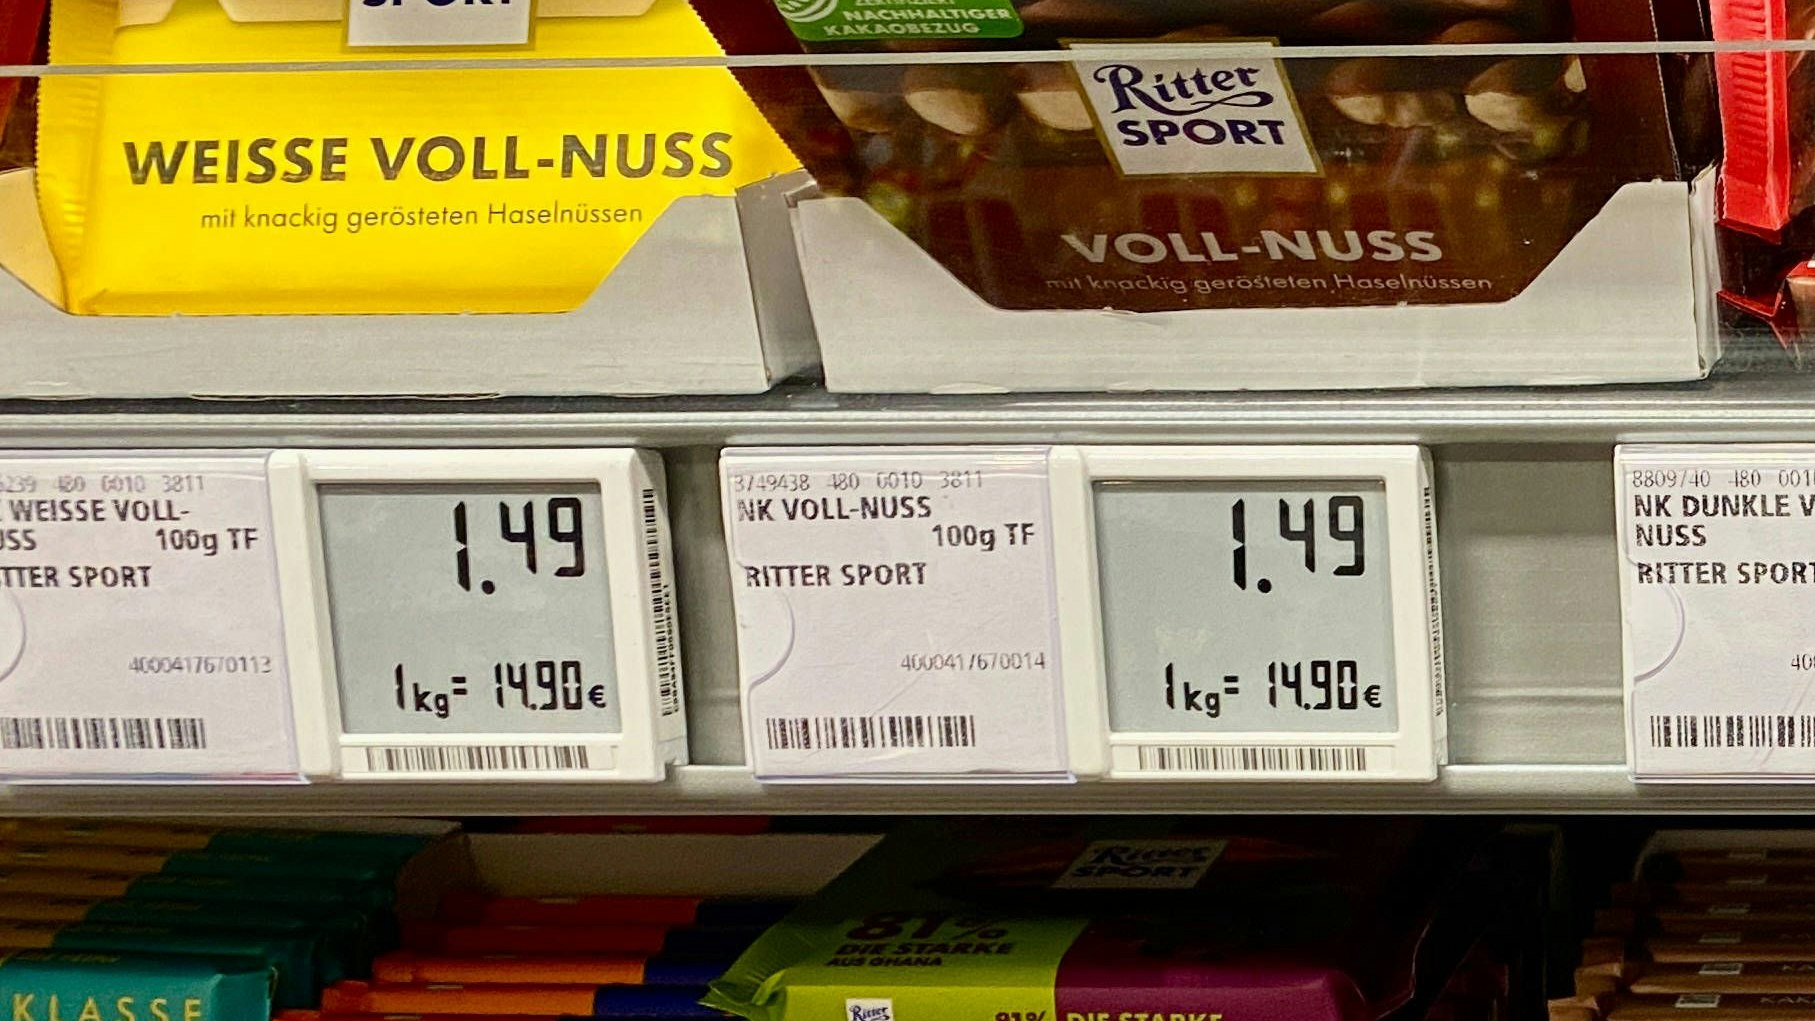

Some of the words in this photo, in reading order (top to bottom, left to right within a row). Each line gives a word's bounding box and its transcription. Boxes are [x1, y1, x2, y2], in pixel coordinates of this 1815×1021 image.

[843, 9, 1010, 21] NACHHALTIGER
[824, 23, 980, 36] KAKAOBEZUG
[1094, 64, 1275, 115] Ritter
[1123, 120, 1285, 146] SPORT
[124, 138, 348, 185] WEISSE
[371, 132, 734, 181] VOLL-NUSS
[202, 206, 236, 229] mit
[243, 203, 338, 234] knackig
[348, 203, 478, 234] gerösteten
[488, 200, 643, 227] Haselnüssen
[1061, 230, 1442, 263] VOLL-NUSS
[1046, 279, 1081, 291] mit
[1092, 276, 1186, 294] knackig
[1194, 275, 1327, 294] gerösteten
[1336, 274, 1491, 291] Haselnüssen
[10, 500, 105, 521] WEISSE
[113, 500, 189, 521] VOLL-
[737, 499, 773, 522] NK
[781, 497, 931, 520] VOLL-NUSS
[1636, 495, 1673, 518] NK
[1682, 495, 1791, 518] DUNKLE
[156, 528, 217, 556] 100g
[227, 528, 258, 549] TF
[455, 497, 585, 594] 1.49
[932, 525, 995, 551] 100g
[1005, 523, 1035, 546] TF
[1231, 496, 1365, 594] 1.49
[1636, 524, 1708, 547] NUSS
[69, 566, 150, 587] SPORT
[746, 565, 831, 587] RITTER
[841, 562, 927, 586] SPORT
[1638, 562, 1727, 585] RITTER
[495, 661, 606, 712] 14.90€
[1268, 660, 1381, 710] 14.90€
